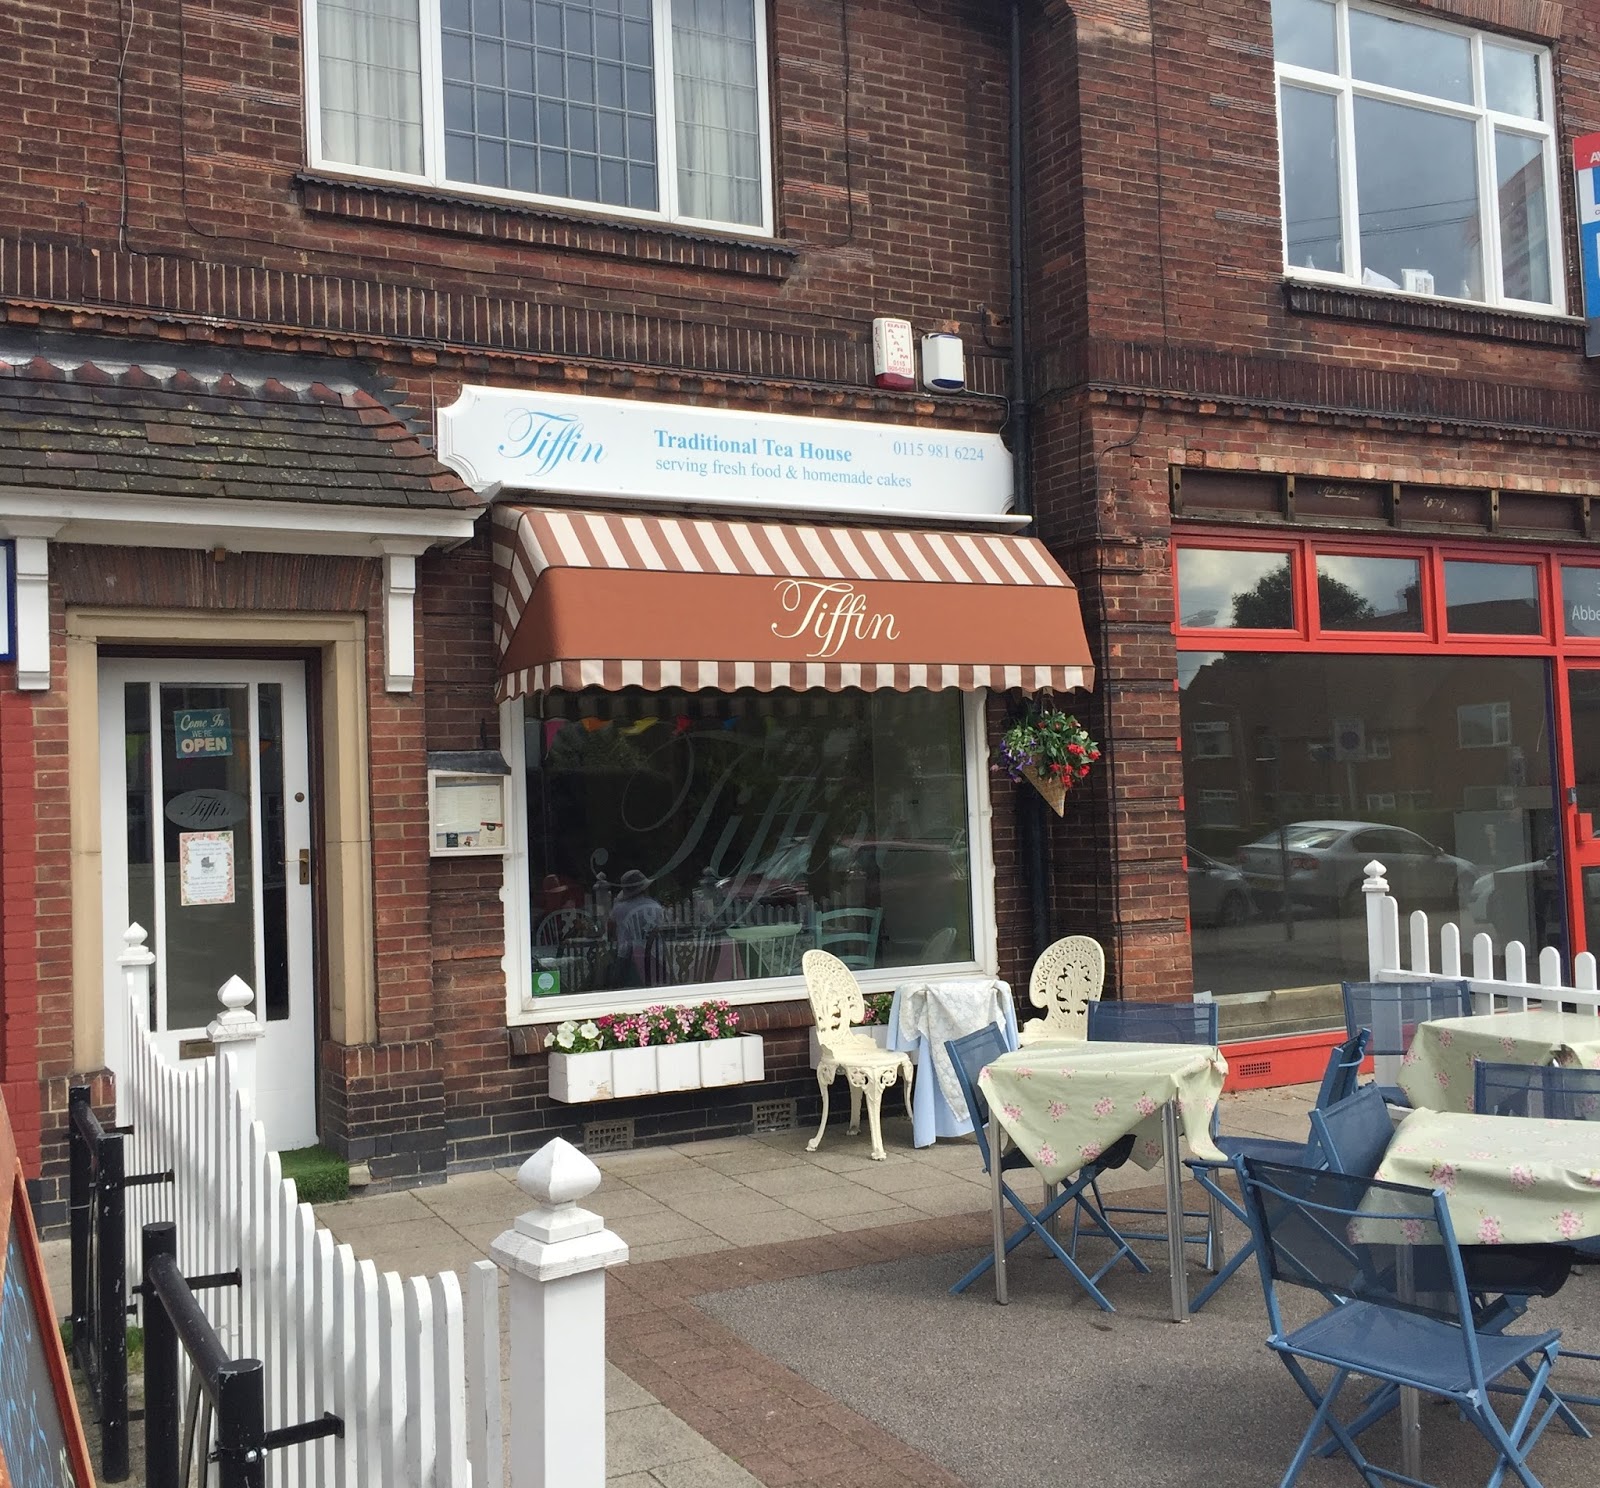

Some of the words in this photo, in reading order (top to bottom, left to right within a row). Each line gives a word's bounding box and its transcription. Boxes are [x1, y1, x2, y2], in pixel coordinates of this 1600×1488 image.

[498, 407, 608, 477] Tiffin
[654, 429, 758, 455] Traditional
[763, 438, 793, 458] Tea
[800, 441, 853, 462] House
[893, 440, 924, 456] 0115
[928, 443, 949, 459] 981
[954, 446, 985, 461] 6224
[655, 457, 708, 477] serving
[713, 459, 746, 476] fresh
[751, 462, 781, 478] food
[785, 465, 798, 480] &
[802, 466, 873, 485] homemade
[876, 472, 912, 488] cakes
[771, 579, 900, 657] Tiffin
[180, 714, 207, 731] Come
[211, 713, 225, 728] In
[191, 729, 213, 738] WE'RE
[181, 736, 227, 753] OPEN
[180, 795, 233, 823] Tiffin
